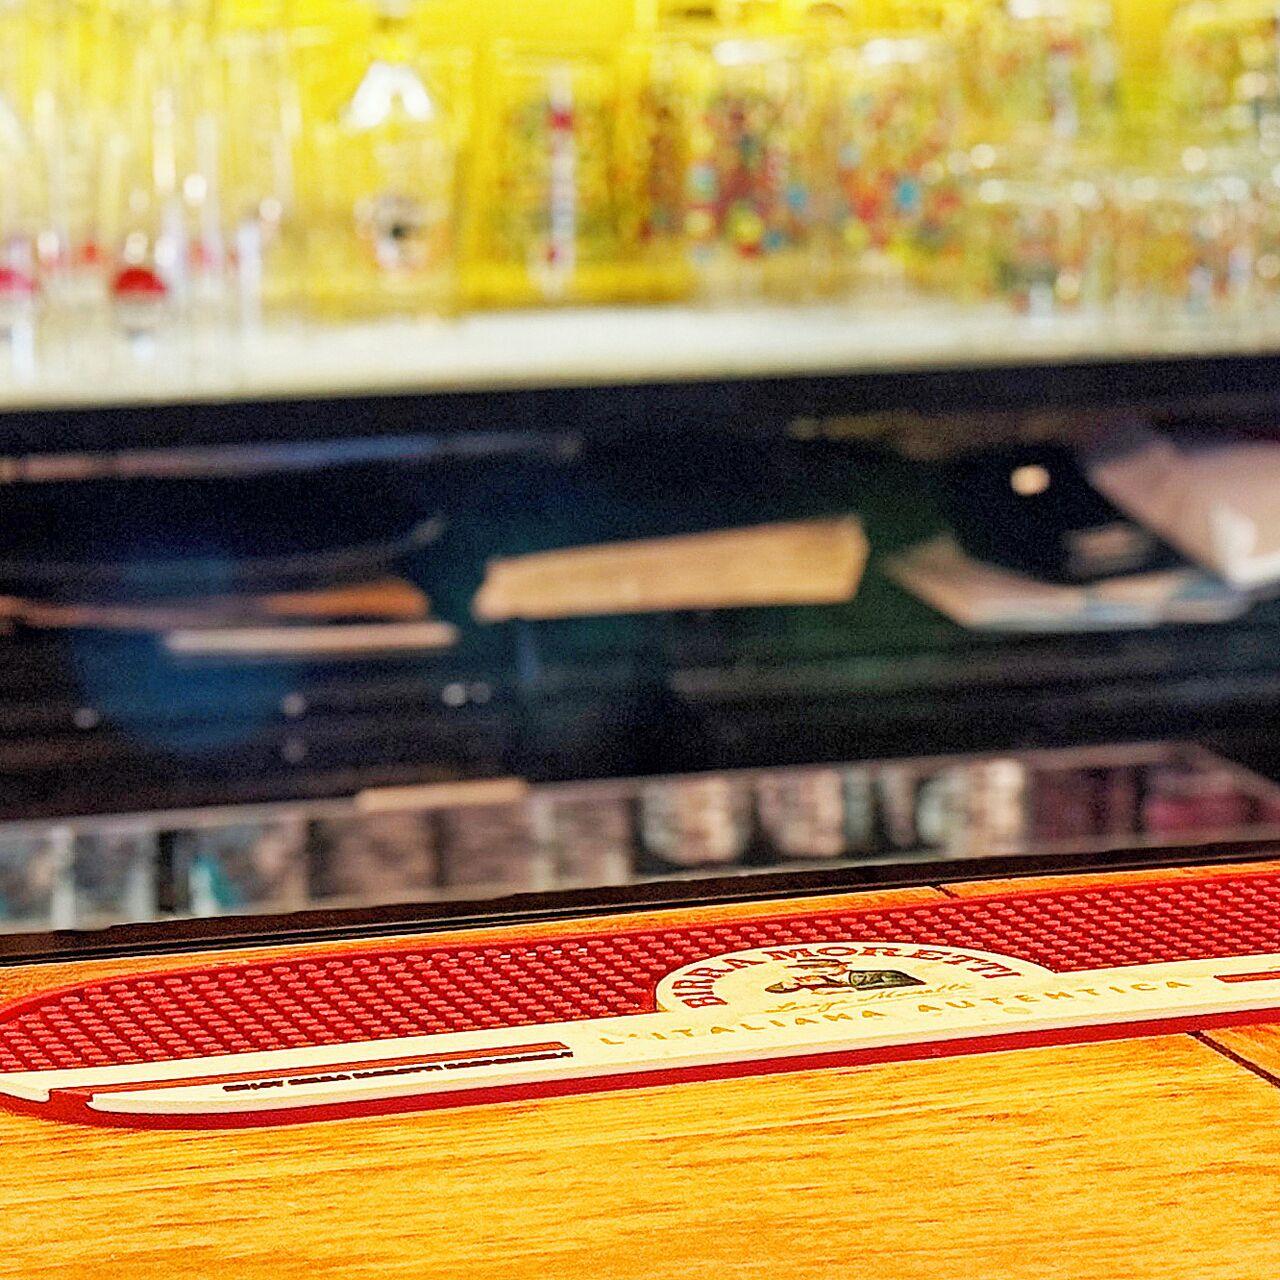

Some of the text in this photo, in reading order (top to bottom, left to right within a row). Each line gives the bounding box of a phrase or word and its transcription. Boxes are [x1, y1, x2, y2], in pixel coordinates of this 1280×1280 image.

[671, 946, 1022, 1009] BIRRA MORETTI
[599, 980, 1191, 1045] L'ITALIANA AUTENTICA
